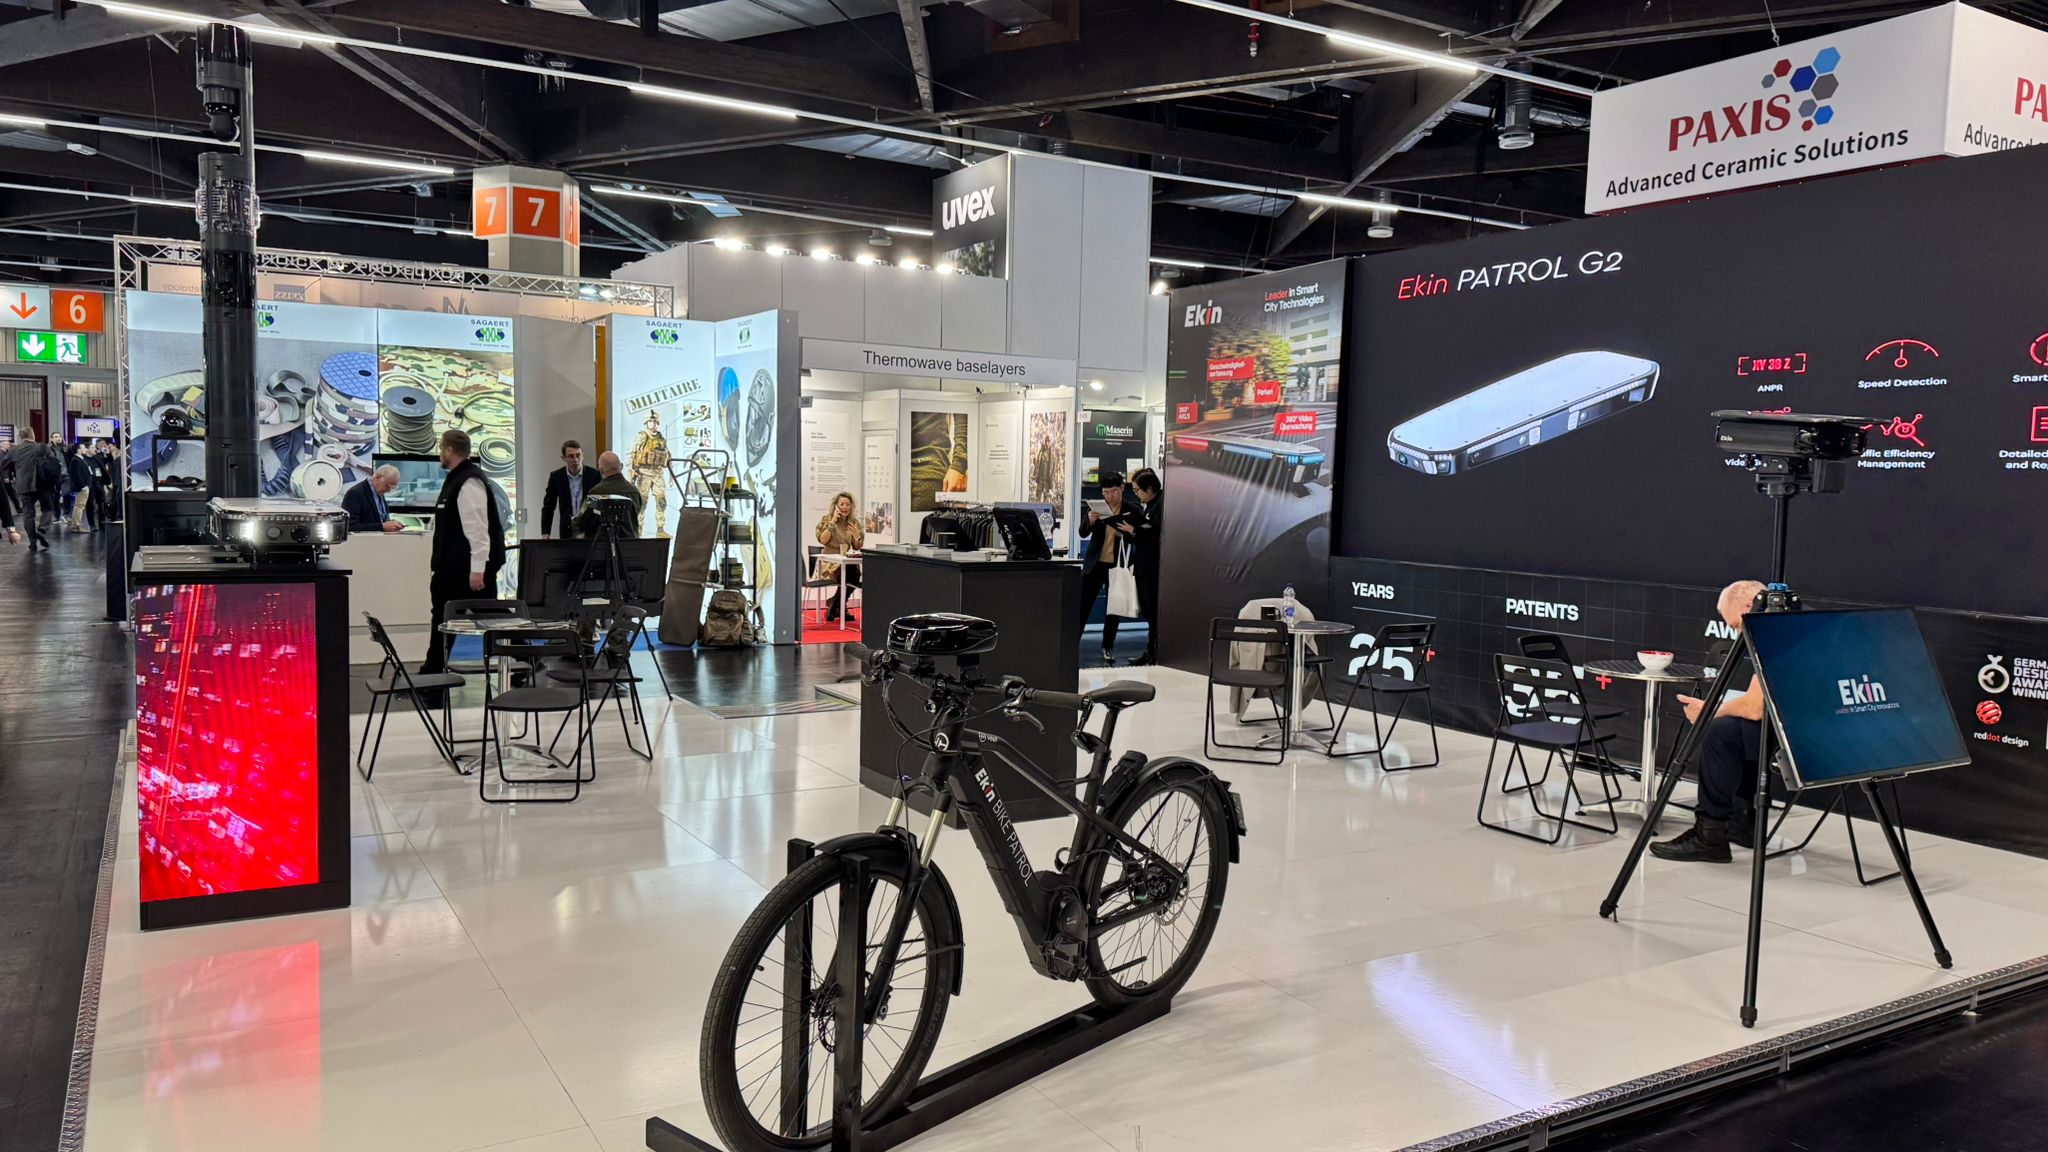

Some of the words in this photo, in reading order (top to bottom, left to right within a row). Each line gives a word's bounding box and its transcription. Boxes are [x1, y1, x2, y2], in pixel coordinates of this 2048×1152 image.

[1668, 93, 1791, 152] PAXIS
[1606, 164, 1696, 198] Advanced
[1701, 147, 1787, 181] Ceramic
[1793, 128, 1909, 165] Solutions
[484, 196, 497, 227] 7
[528, 196, 545, 228] 7
[942, 185, 996, 231] uvex
[1398, 273, 1449, 300] Ekin
[1457, 256, 1568, 292] PATROL
[1578, 250, 1624, 275] G2
[1264, 287, 1290, 301] Leader
[1296, 282, 1320, 296] Smart
[69, 294, 87, 325] 6
[1184, 299, 1224, 328] Ekin
[1264, 301, 1279, 314] City
[1279, 294, 1325, 312] Technologies
[470, 319, 510, 328] SAGAERT
[646, 320, 683, 329] SAGAERT
[862, 350, 953, 372] Thermowave
[956, 358, 1027, 379] baselayers
[631, 378, 702, 411] MILITAIRE
[1757, 384, 1784, 393] ANPR
[1857, 380, 1891, 390] Speed
[1893, 377, 1948, 388] Detection
[1106, 424, 1133, 435] Maserin
[1857, 459, 1926, 469] Management
[1883, 449, 1936, 460] Efficiency
[2004, 461, 2028, 469] and
[1351, 581, 1395, 600] YEARS
[1505, 597, 1579, 621] PATENTS
[1837, 674, 1887, 706] Ekin
[2001, 735, 2030, 748] design
[974, 767, 996, 803] Ekin
[992, 799, 1011, 835] BIKE
[1006, 833, 1034, 887] PATROL
